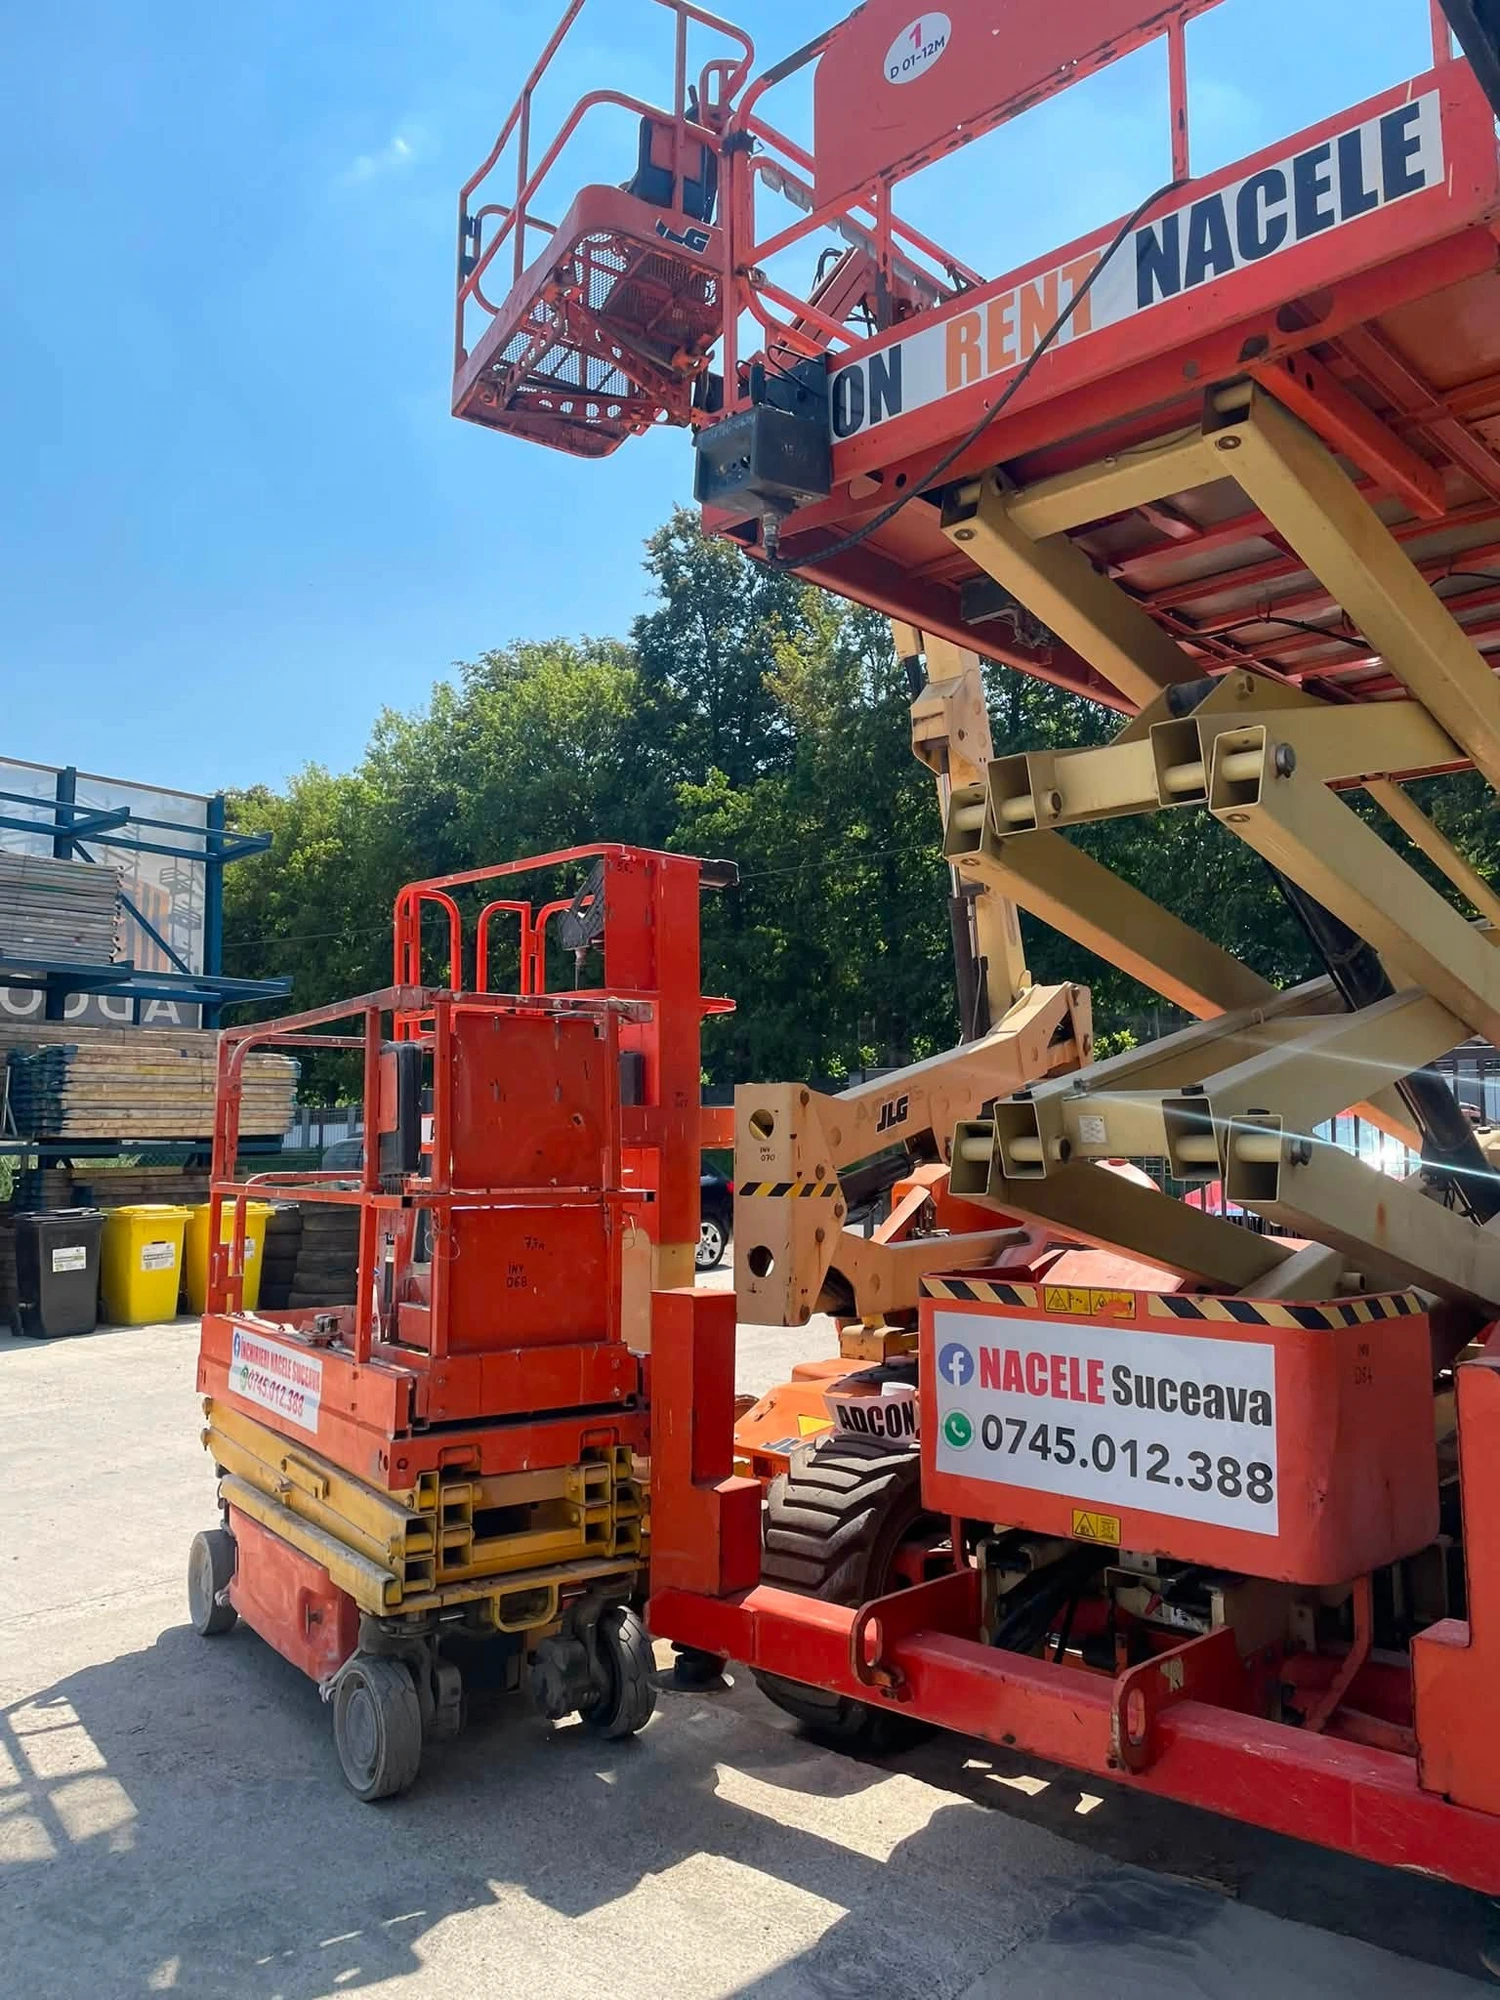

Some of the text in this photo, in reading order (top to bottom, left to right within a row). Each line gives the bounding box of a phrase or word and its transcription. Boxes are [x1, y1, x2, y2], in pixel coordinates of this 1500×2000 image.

[889, 35, 945, 80] D 01-12M
[909, 22, 922, 50] 1
[832, 101, 1426, 439] ON RENT NACELE
[876, 1094, 909, 1134] JLG
[247, 1368, 305, 1417] 0745.012.388
[978, 1346, 1273, 1427] NACELE Suceava
[836, 1400, 916, 1439] ADCON
[980, 1413, 1275, 1505] 0745.012.388
